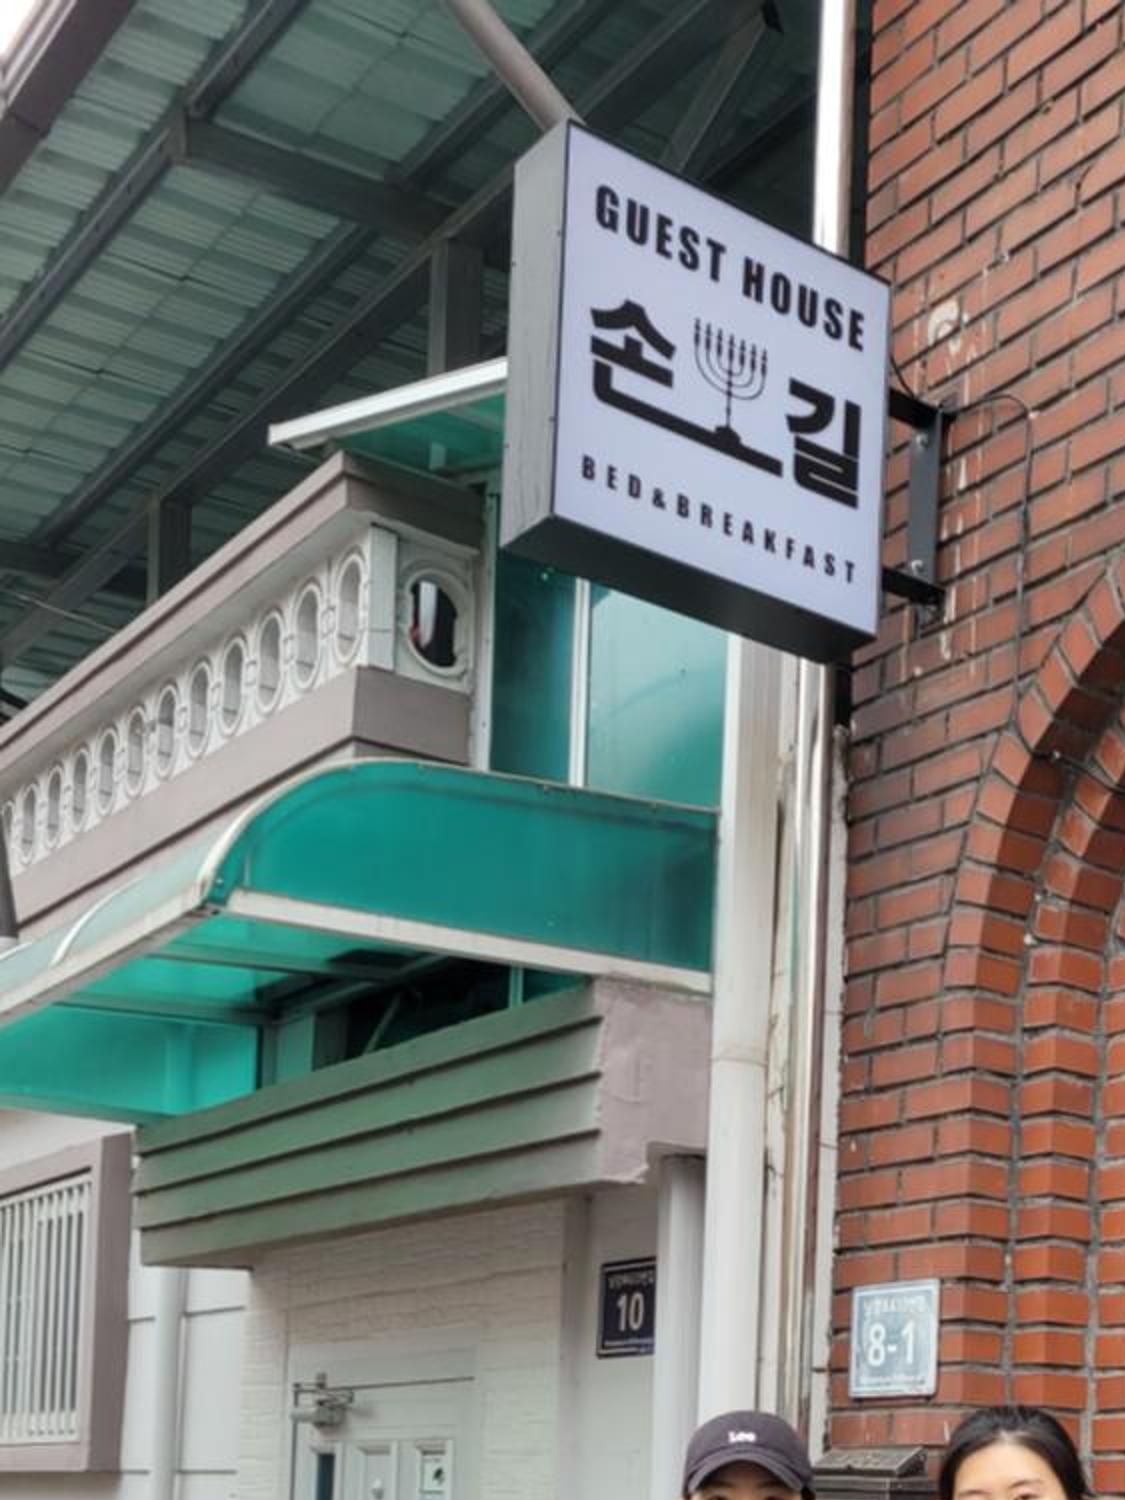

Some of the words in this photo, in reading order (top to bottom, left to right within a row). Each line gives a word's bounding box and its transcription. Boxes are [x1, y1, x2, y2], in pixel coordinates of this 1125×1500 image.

[595, 185, 726, 282] GUEST
[743, 256, 865, 352] HOUSE
[582, 455, 857, 583] BED&BREAKFAST
[617, 1293, 645, 1331] 10
[868, 1320, 915, 1367] 8-1
